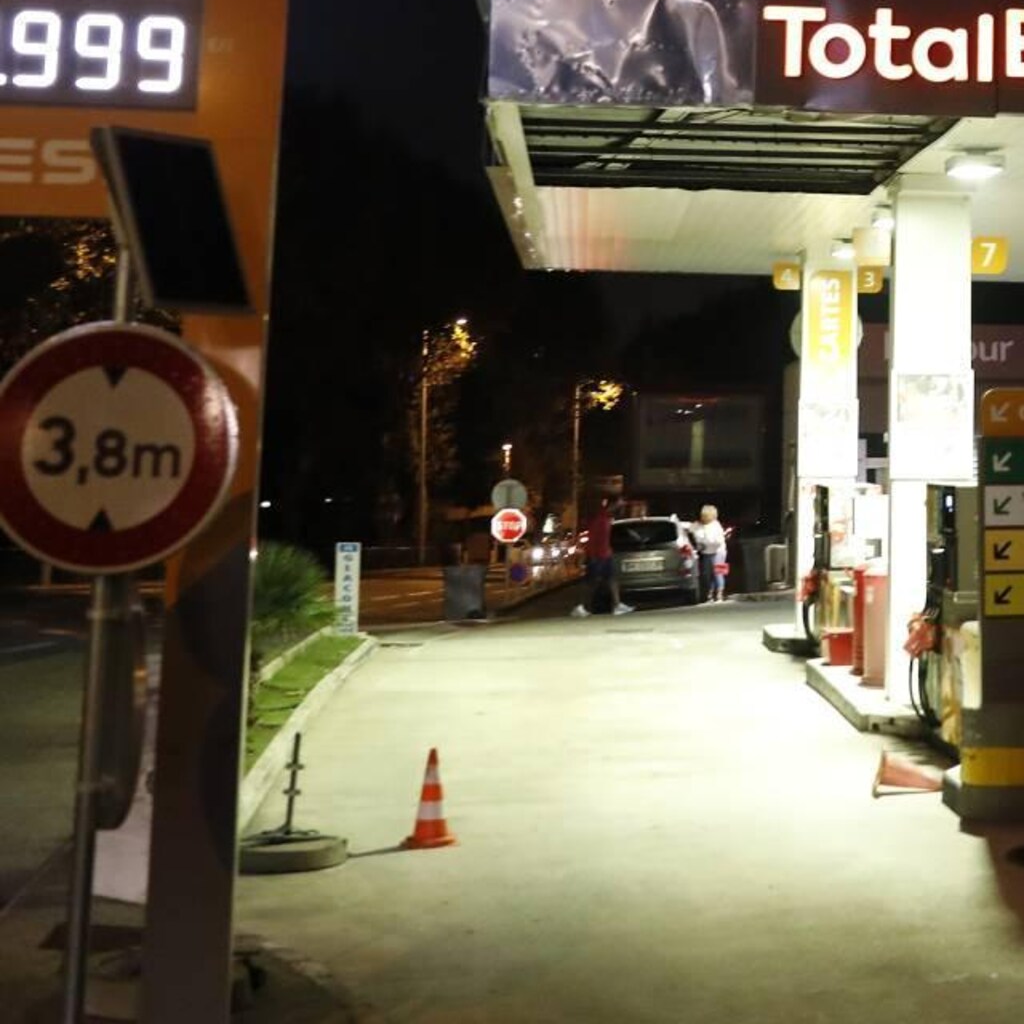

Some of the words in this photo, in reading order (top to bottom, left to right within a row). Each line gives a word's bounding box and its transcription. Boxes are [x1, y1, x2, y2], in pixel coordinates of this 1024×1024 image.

[979, 242, 998, 267] 7
[863, 271, 876, 288] 3
[33, 416, 182, 485] 3,8m
